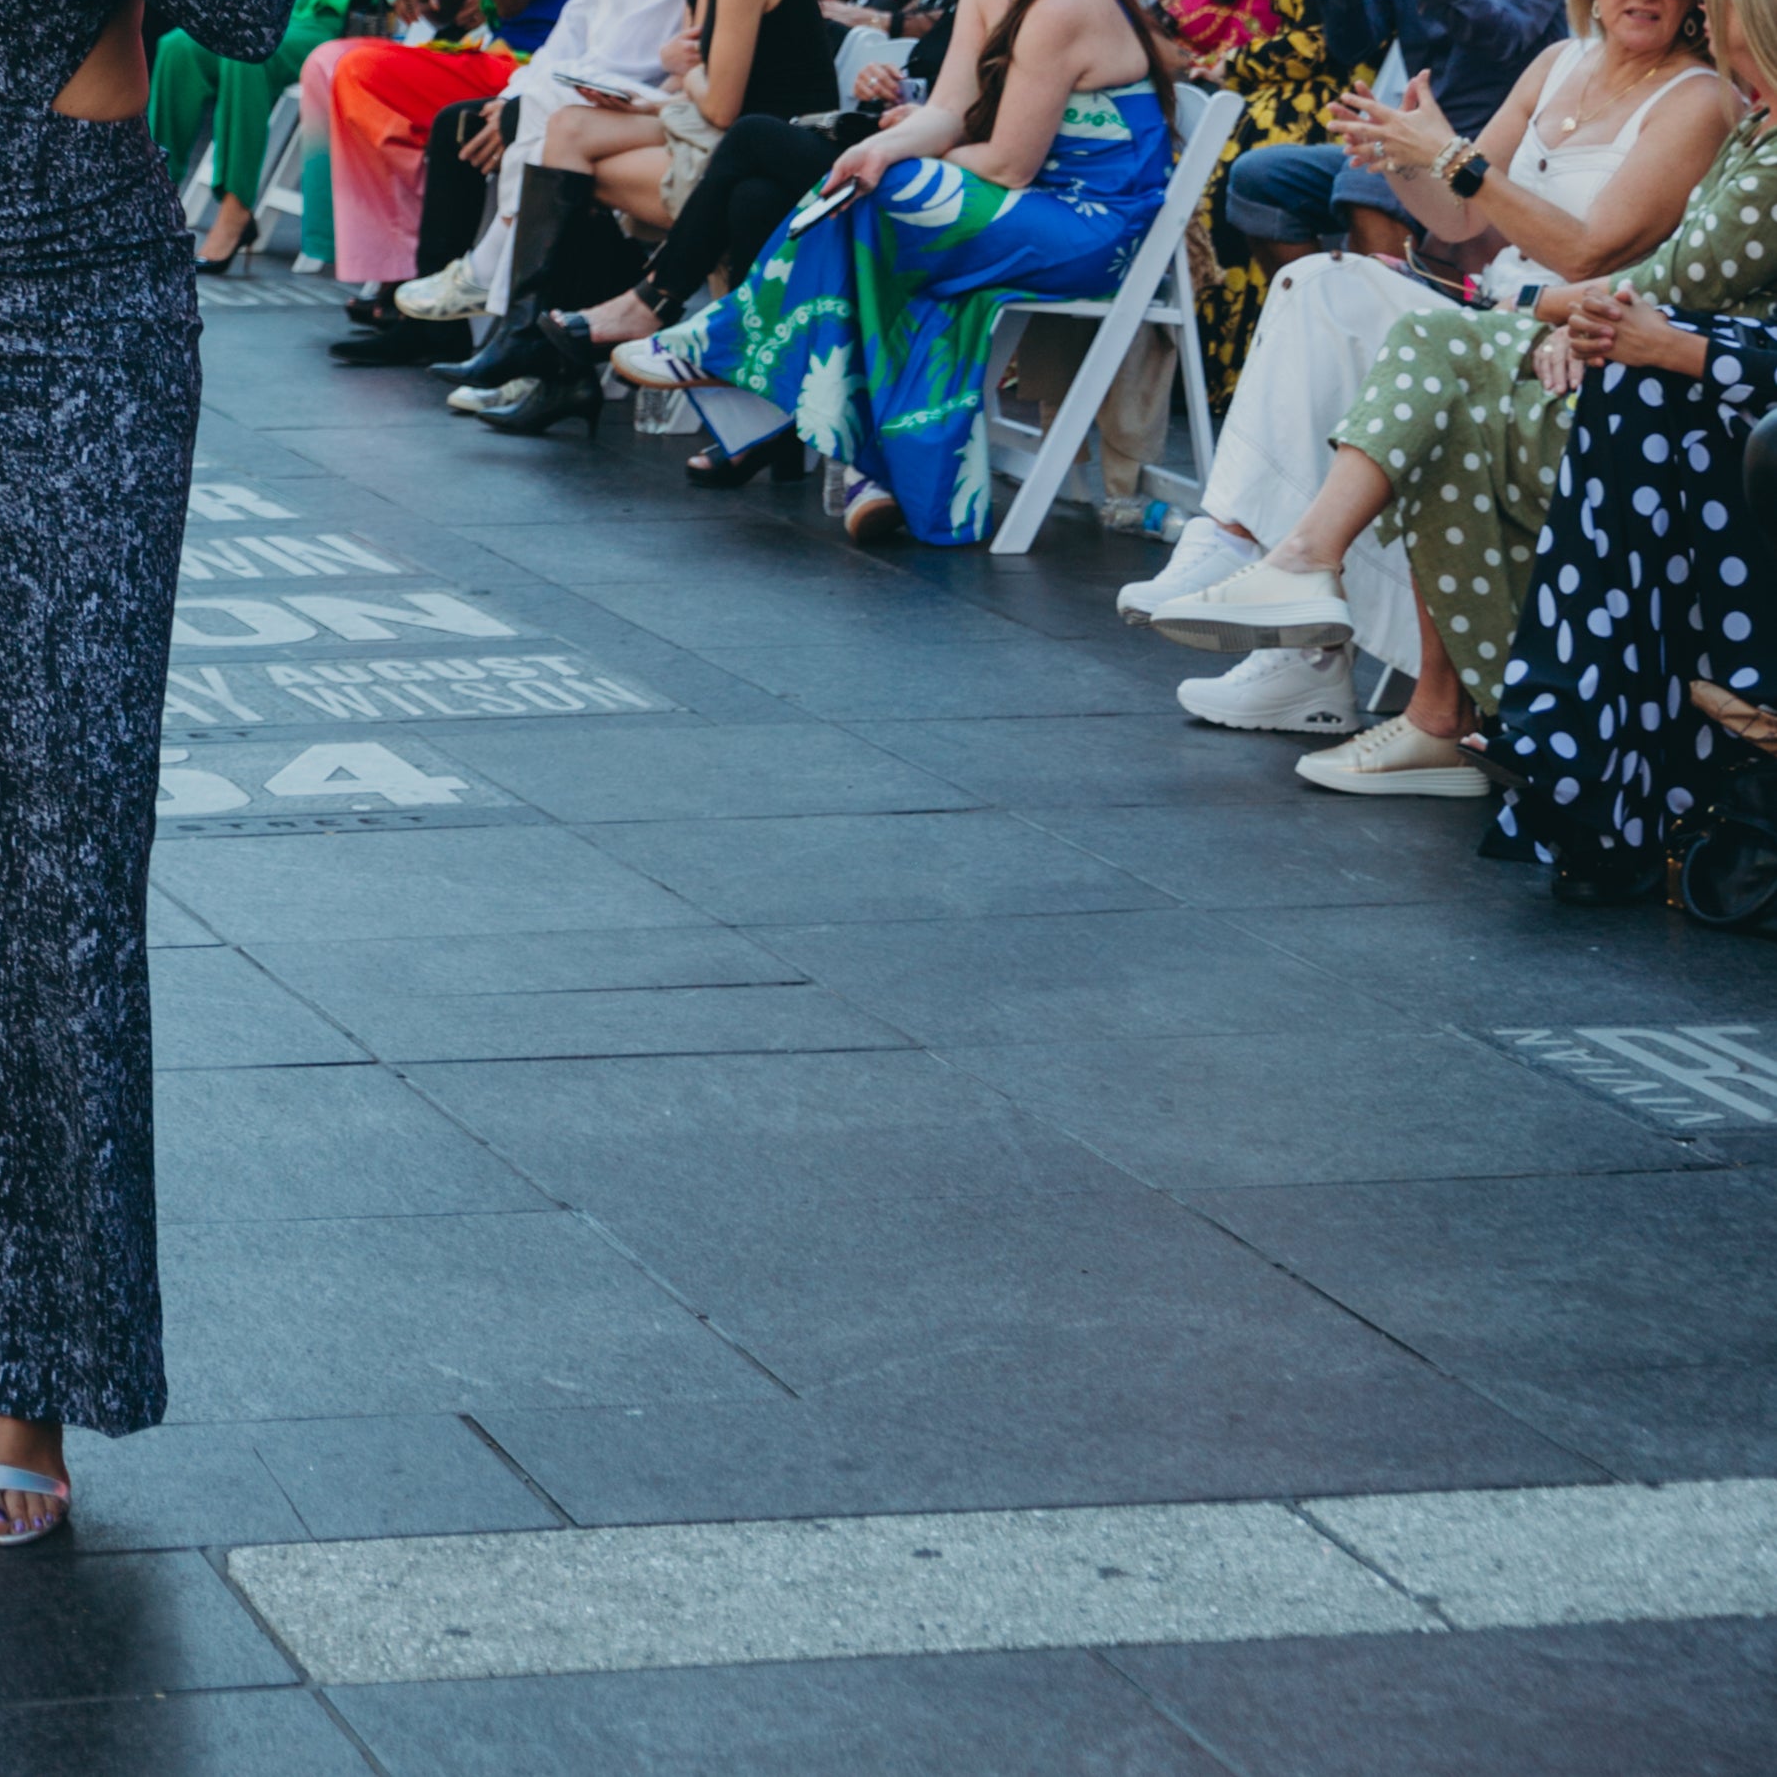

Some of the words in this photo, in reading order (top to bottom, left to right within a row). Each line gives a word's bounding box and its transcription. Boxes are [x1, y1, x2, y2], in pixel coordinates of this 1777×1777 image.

[265, 655, 581, 686] AUGUST
[287, 677, 652, 719] WILSON
[177, 815, 425, 832] STREET
[1493, 1028, 1726, 1127] VIVIAN
